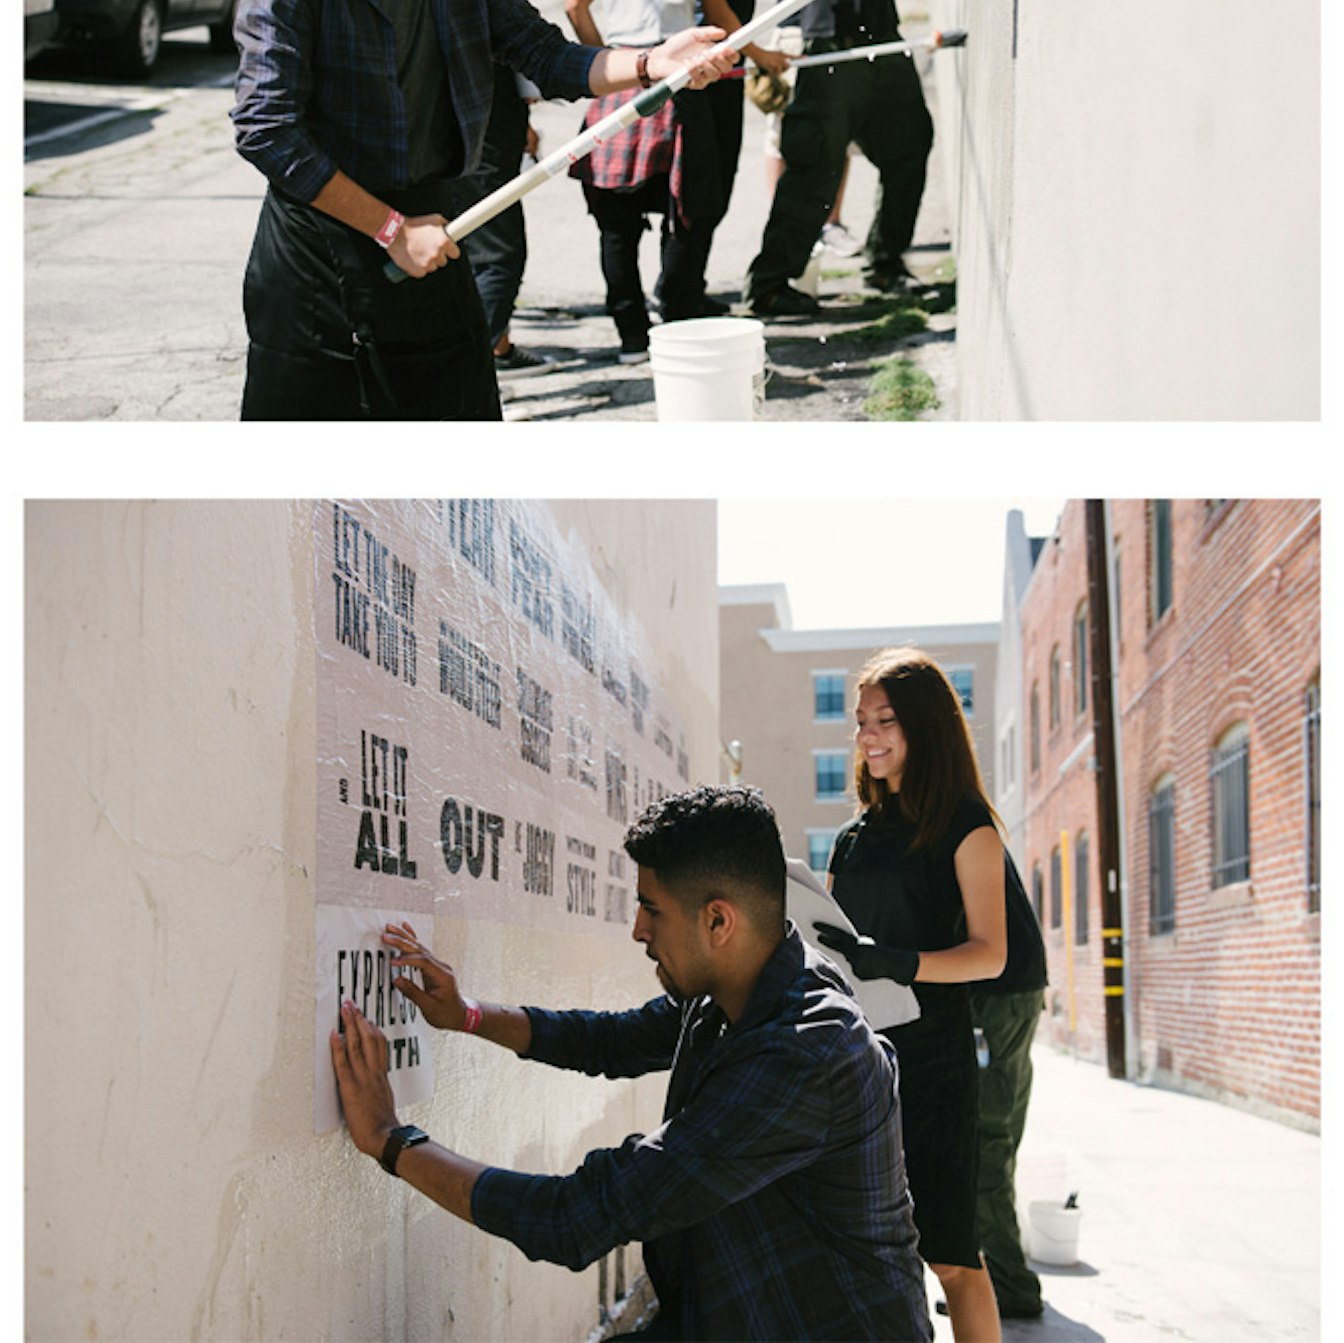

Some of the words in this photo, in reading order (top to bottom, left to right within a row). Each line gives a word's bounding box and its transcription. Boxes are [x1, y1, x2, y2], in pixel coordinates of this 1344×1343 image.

[333, 504, 360, 582] LET
[364, 529, 389, 607] THE
[392, 554, 416, 625] DAY
[332, 572, 370, 660] TAKE
[373, 604, 398, 677] YOU
[401, 624, 416, 687] TO
[362, 729, 388, 811] LET
[354, 811, 417, 879] ALL
[440, 796, 505, 881] OUT
